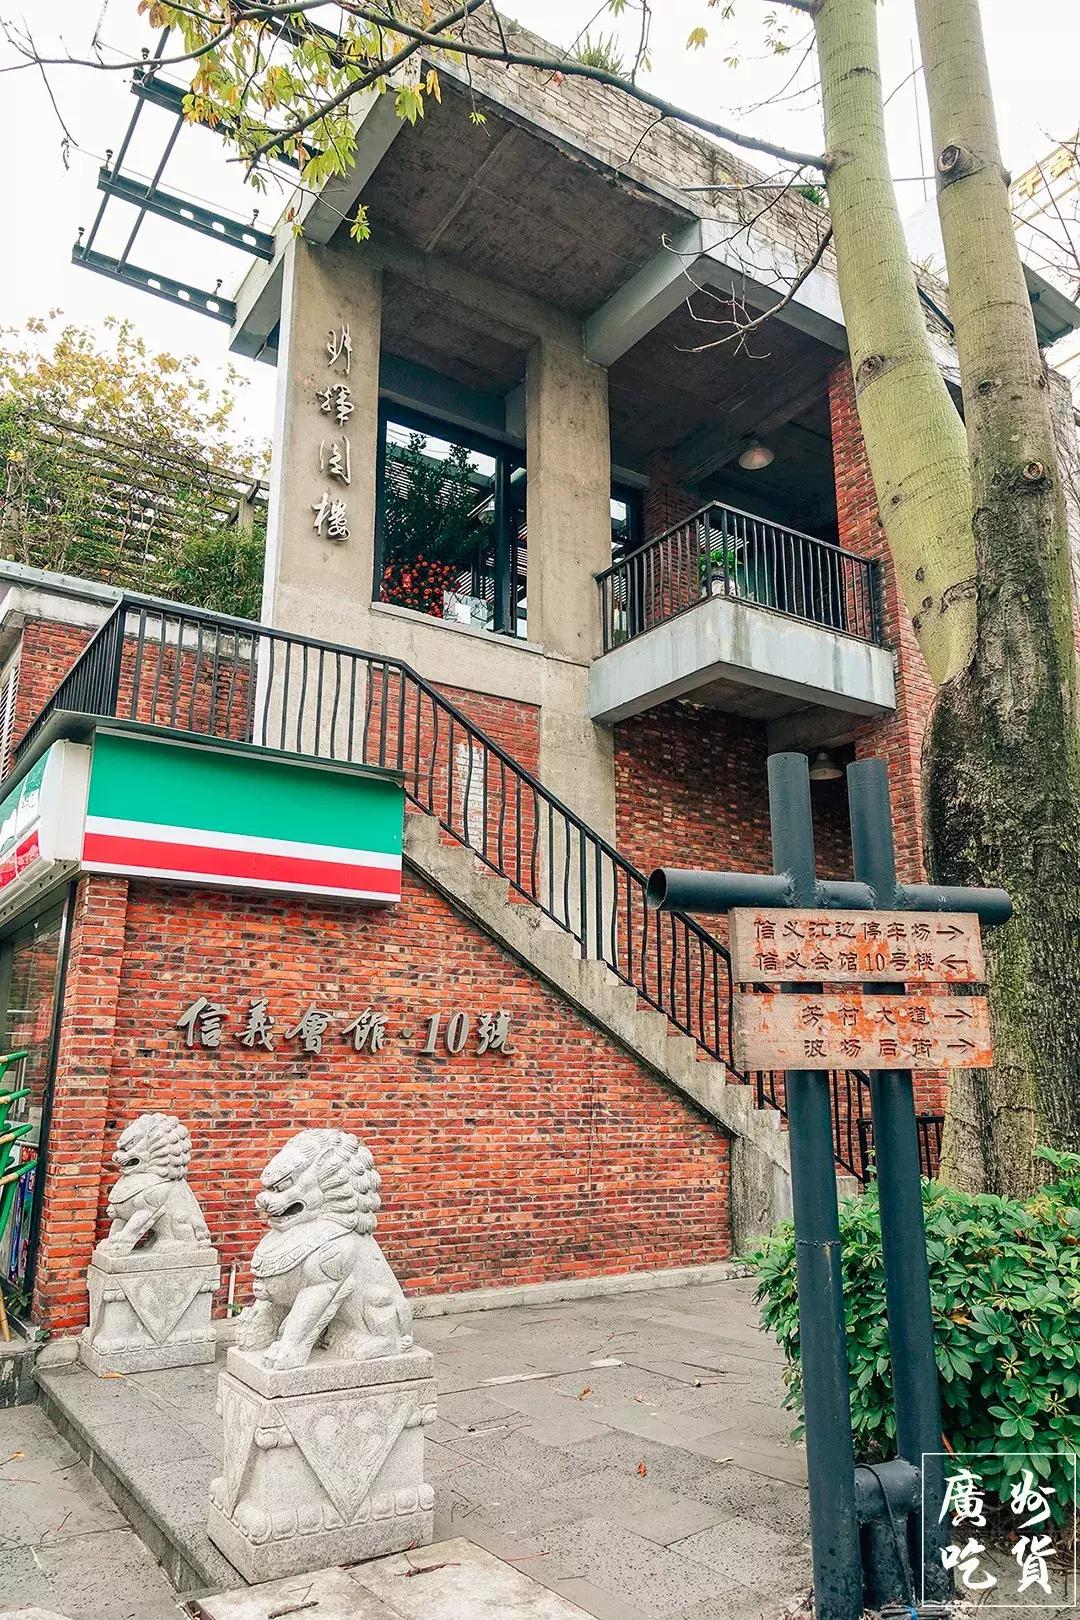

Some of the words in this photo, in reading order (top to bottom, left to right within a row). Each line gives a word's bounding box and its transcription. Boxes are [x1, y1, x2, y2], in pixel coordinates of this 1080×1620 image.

[753, 920, 932, 942] 信义江边停车场
[756, 951, 936, 974] 信义会馆10号楼
[801, 1005, 931, 1026] 芳村大道
